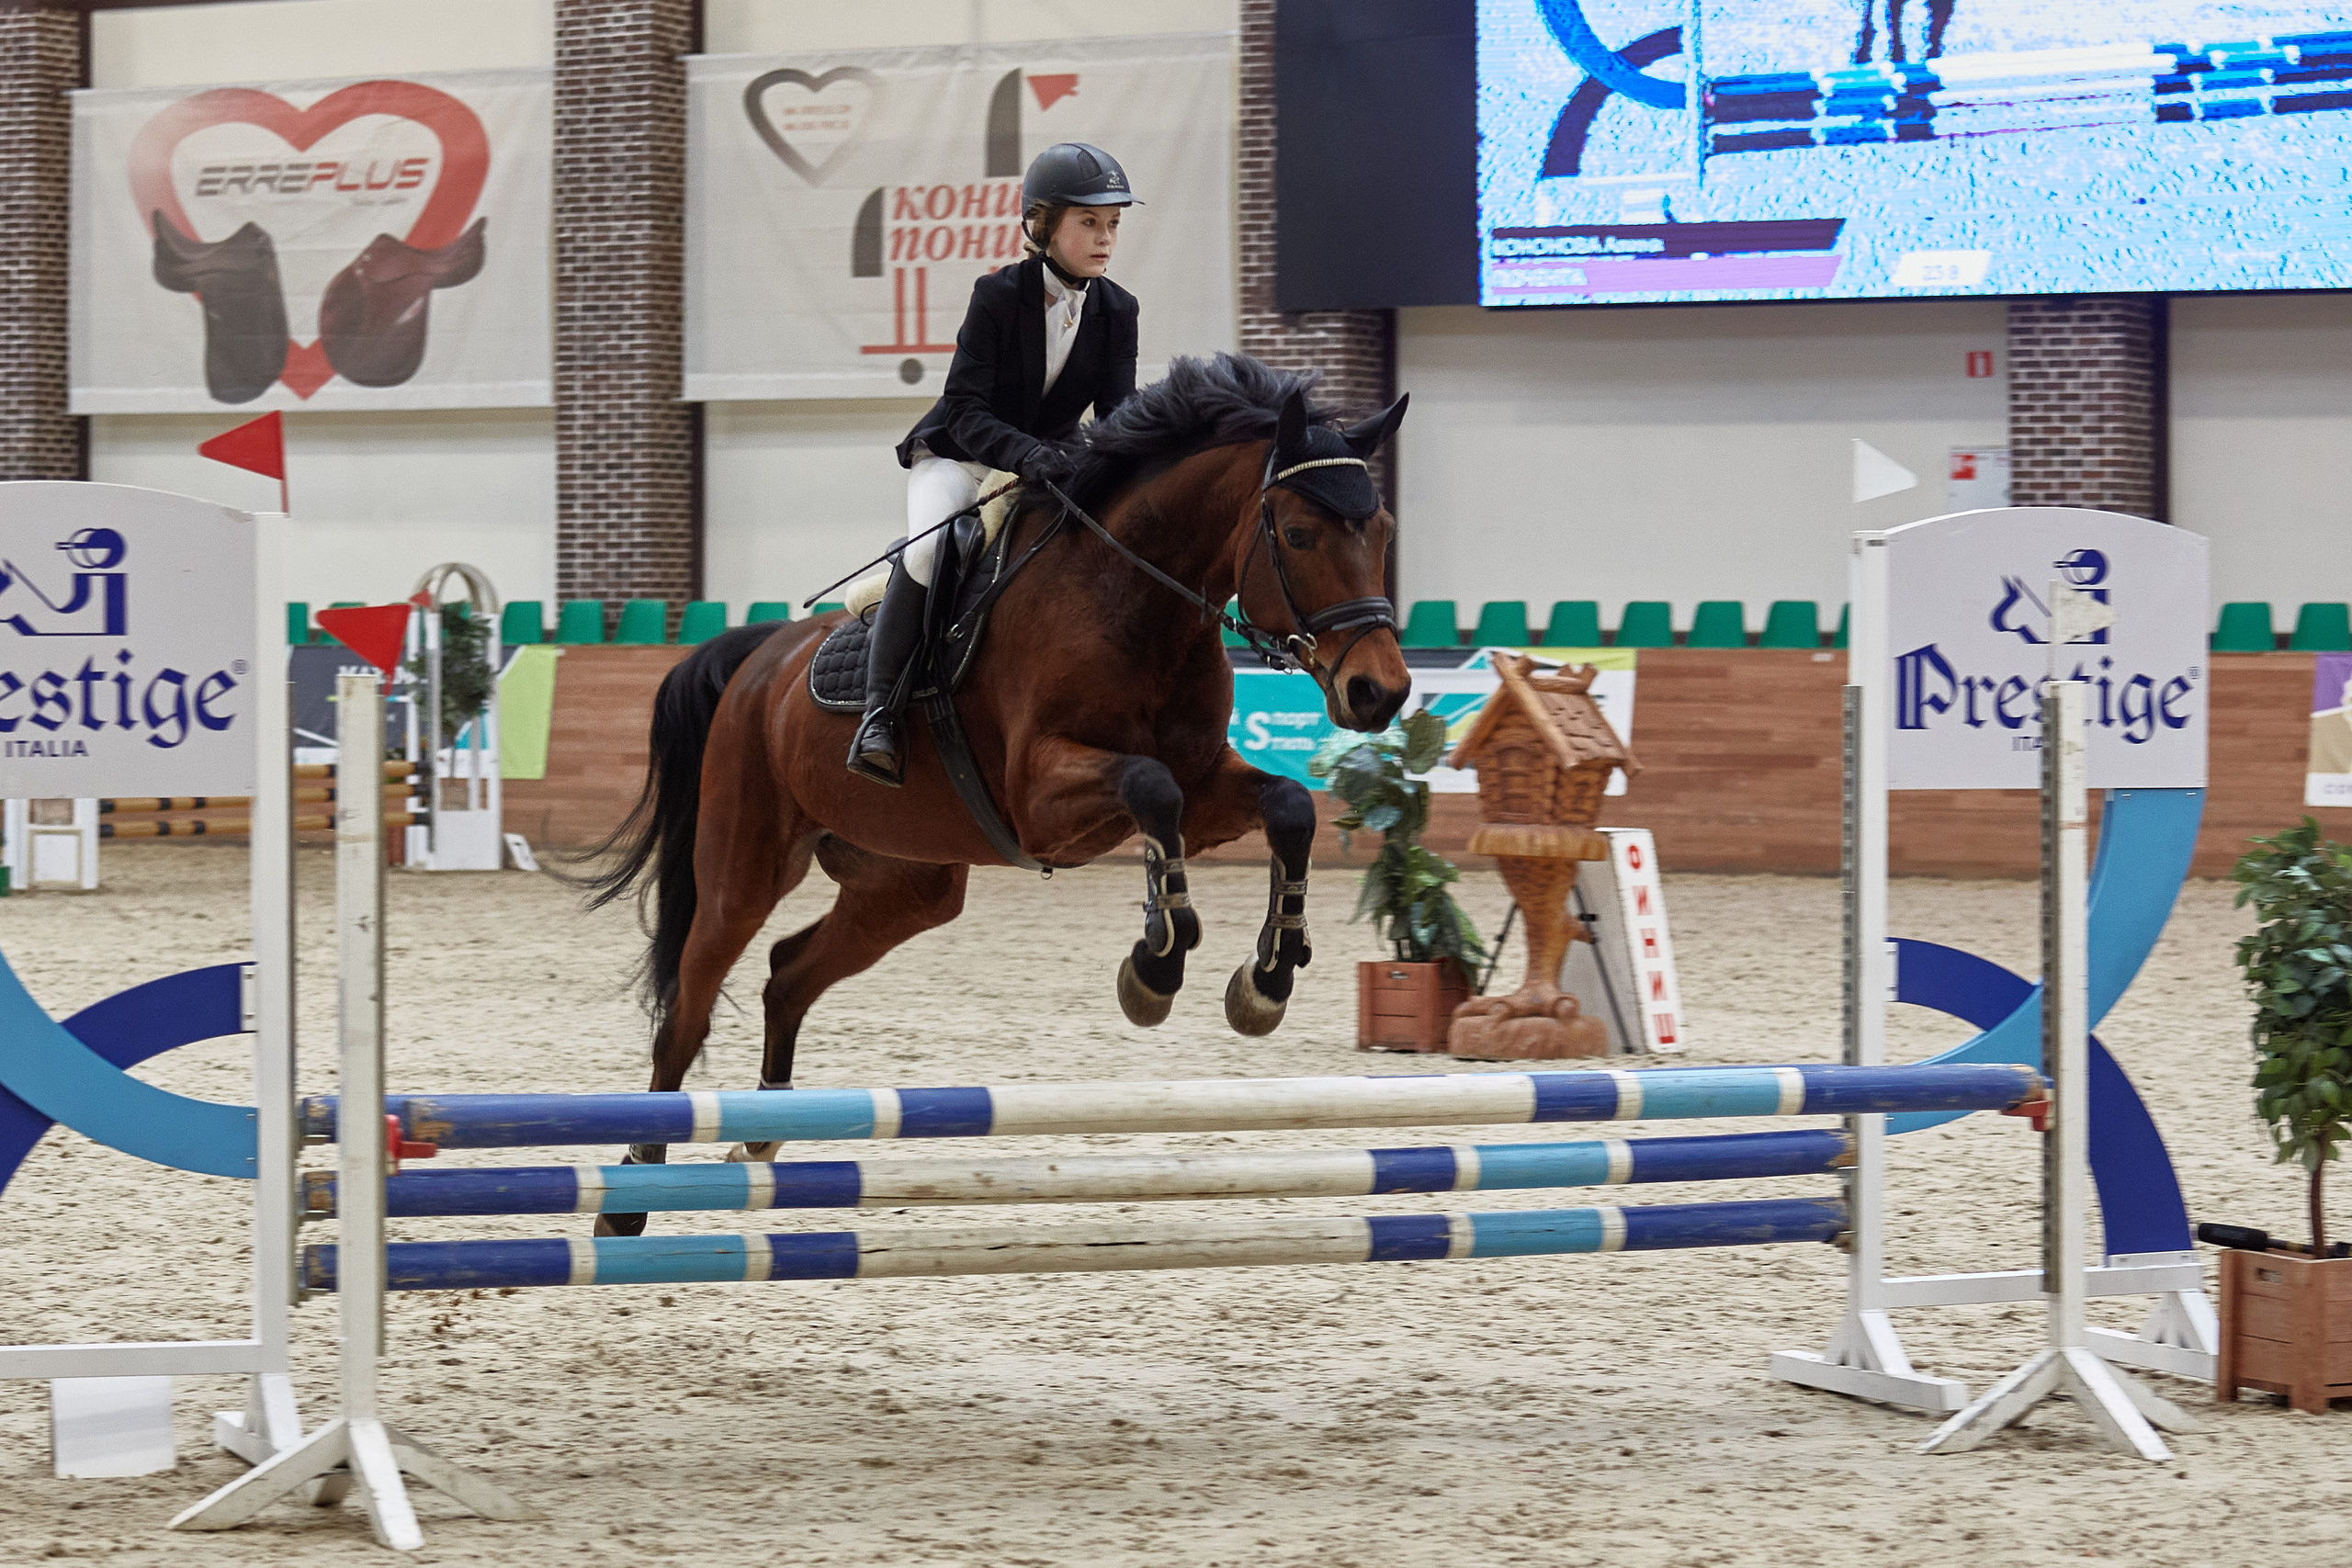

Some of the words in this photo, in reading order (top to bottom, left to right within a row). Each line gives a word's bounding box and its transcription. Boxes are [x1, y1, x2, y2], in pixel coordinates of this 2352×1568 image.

[197, 158, 429, 196] ERREPLUS
[1894, 642, 2192, 744] Preige
[5, 739, 89, 758] ITALIA
[1626, 842, 1677, 1044] ФИНИШ
